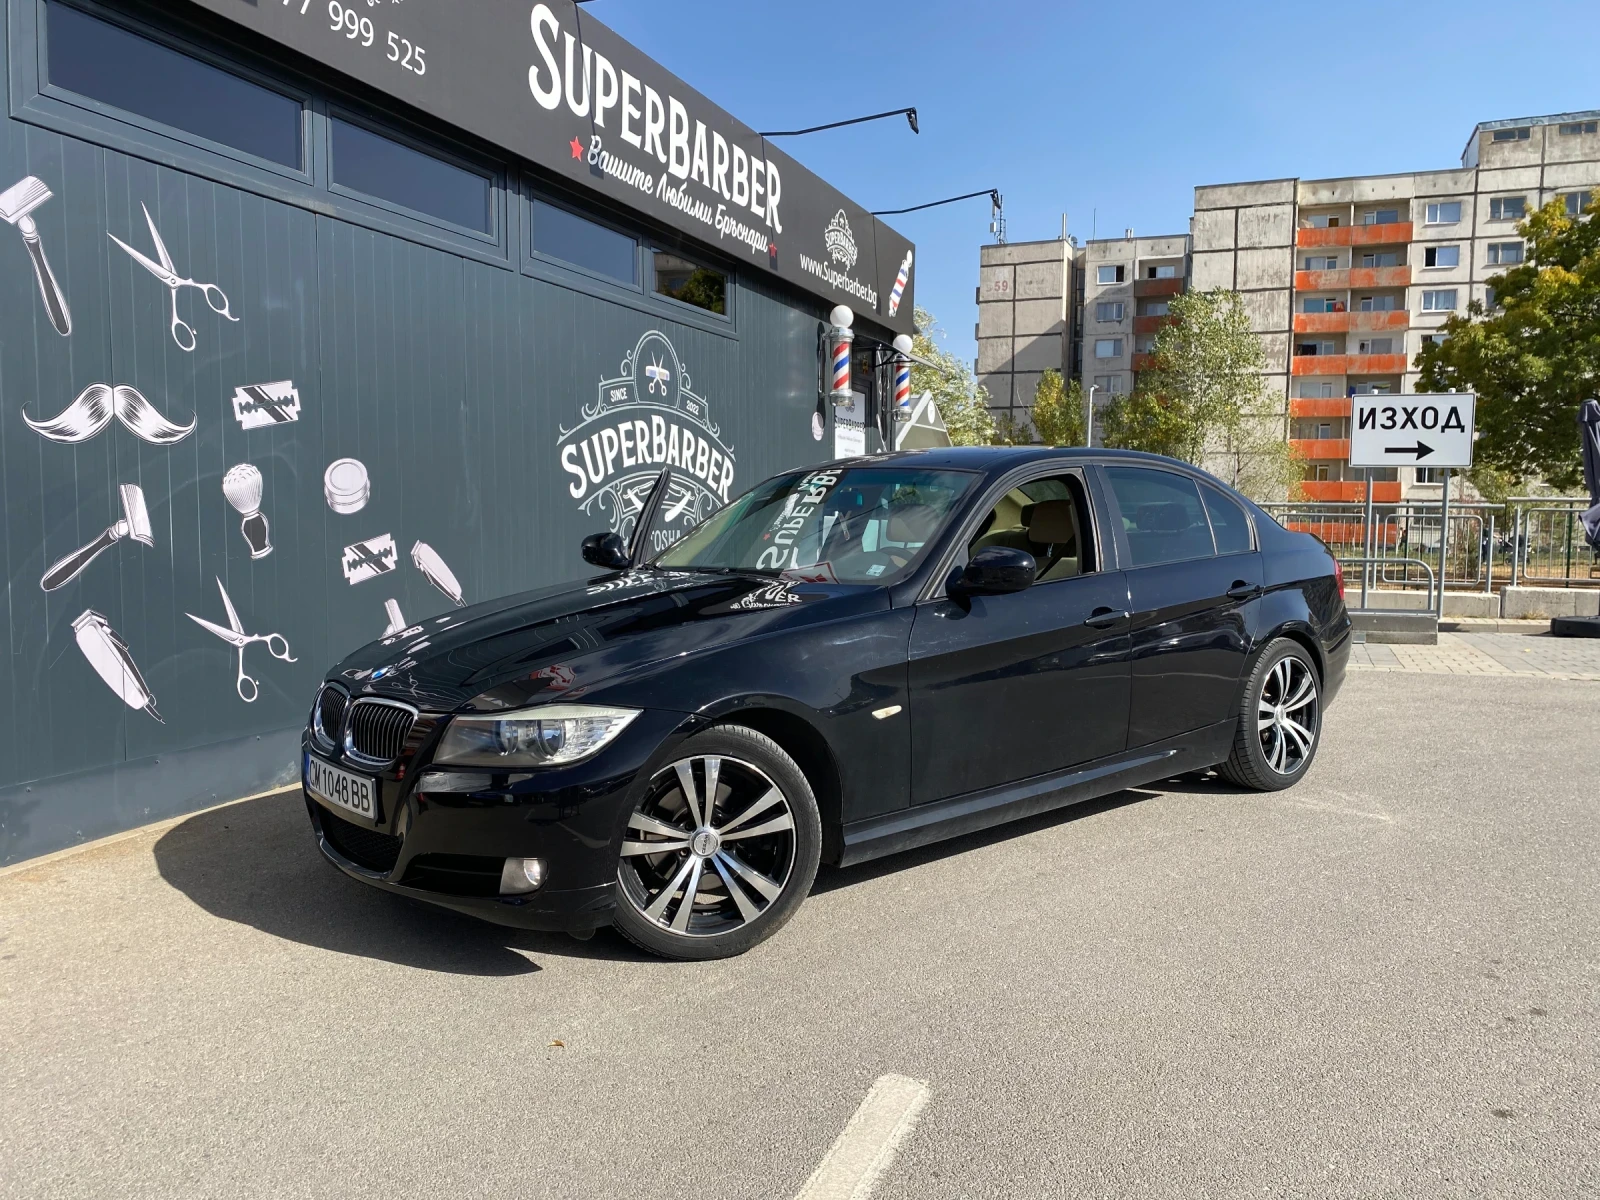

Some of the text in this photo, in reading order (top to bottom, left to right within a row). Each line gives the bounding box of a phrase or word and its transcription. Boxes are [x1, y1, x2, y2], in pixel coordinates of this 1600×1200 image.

[328, 0, 426, 76] 999 525
[528, 3, 783, 234] SUPERBARBER
[587, 135, 653, 194] Вашите
[656, 173, 713, 226] Любими
[799, 253, 877, 310] www.Superbarber.bg
[994, 280, 1008, 291] 59
[610, 387, 699, 415] SINCE 2022
[1358, 406, 1465, 433] ИЗХОД
[561, 414, 735, 504] SUPERBARBER
[323, 767, 349, 805] 1048
